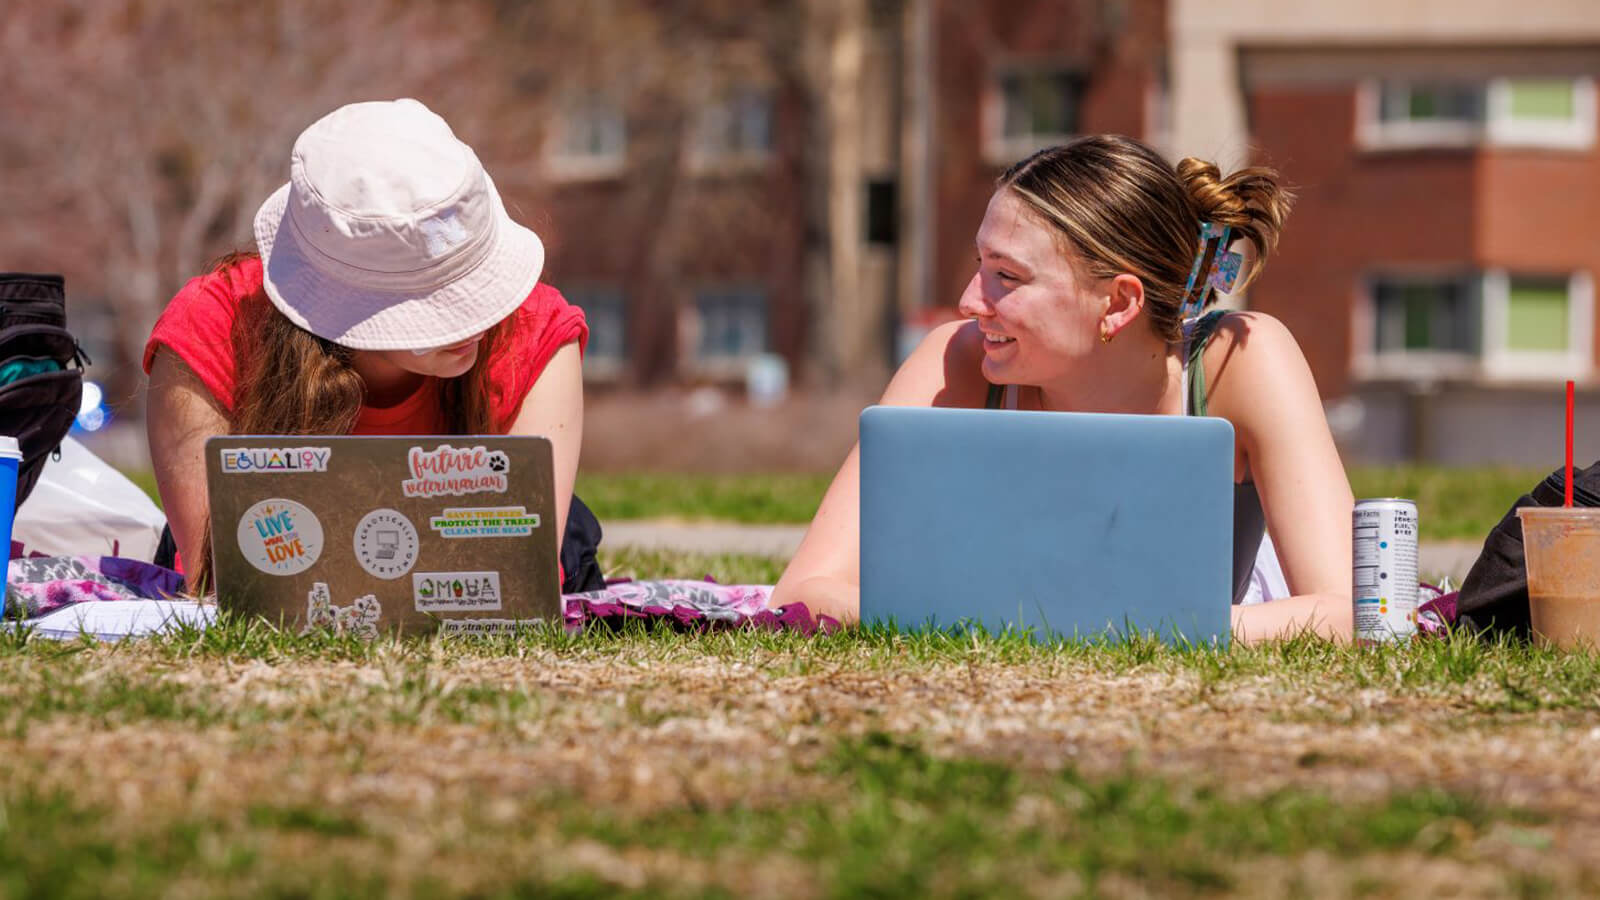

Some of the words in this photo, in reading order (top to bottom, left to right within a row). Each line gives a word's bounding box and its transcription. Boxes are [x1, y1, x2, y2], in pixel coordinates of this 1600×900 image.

[412, 450, 488, 479] future
[406, 475, 504, 494] veterinarian
[255, 510, 294, 538] LIVE
[434, 519, 479, 528] PROTECT
[482, 519, 502, 527] THE
[503, 518, 537, 526] TREES
[443, 527, 478, 536] CLEAN
[480, 527, 499, 535] THE
[501, 526, 529, 535] SEAS
[265, 538, 305, 564] LOVE
